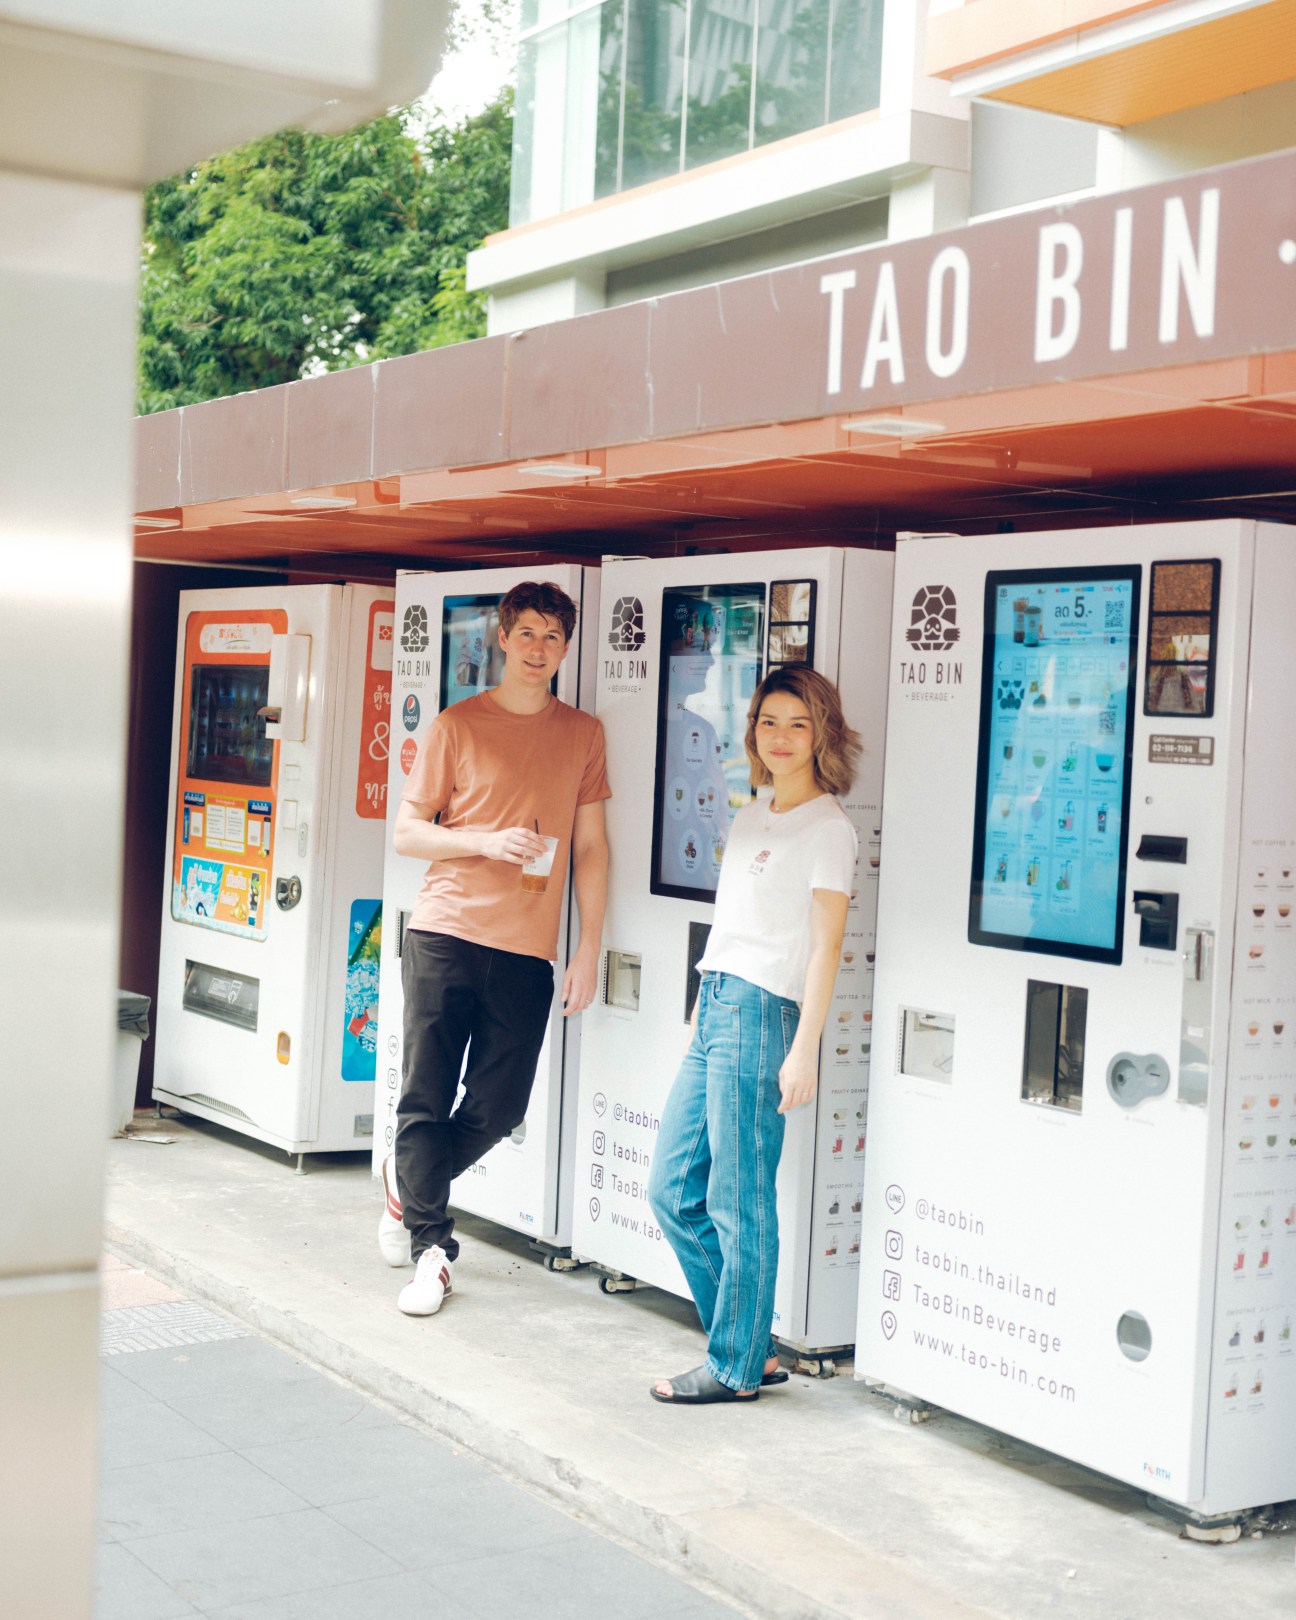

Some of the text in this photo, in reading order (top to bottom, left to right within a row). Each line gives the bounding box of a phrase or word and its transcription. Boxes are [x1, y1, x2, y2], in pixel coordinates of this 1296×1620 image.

[819, 187, 1220, 395] TAO BIN
[397, 660, 431, 677] TAO BIN
[604, 660, 648, 679] TAO BIN
[900, 662, 963, 684] TAO BIN
[402, 681, 423, 689] BEVERAGE
[611, 684, 638, 693] BEVERAGE
[911, 691, 949, 702] BEVERAGE
[404, 714, 418, 725] pepsi
[613, 1103, 660, 1131] @taobin
[888, 1192, 902, 1204] LINE
[914, 1198, 985, 1236] @taobin
[914, 1244, 1058, 1307] taobin.thailand
[912, 1283, 1063, 1353] TaoBinBeverage
[912, 1328, 1077, 1403] www.tao-bin.com
[1142, 1461, 1171, 1482] FORTH
